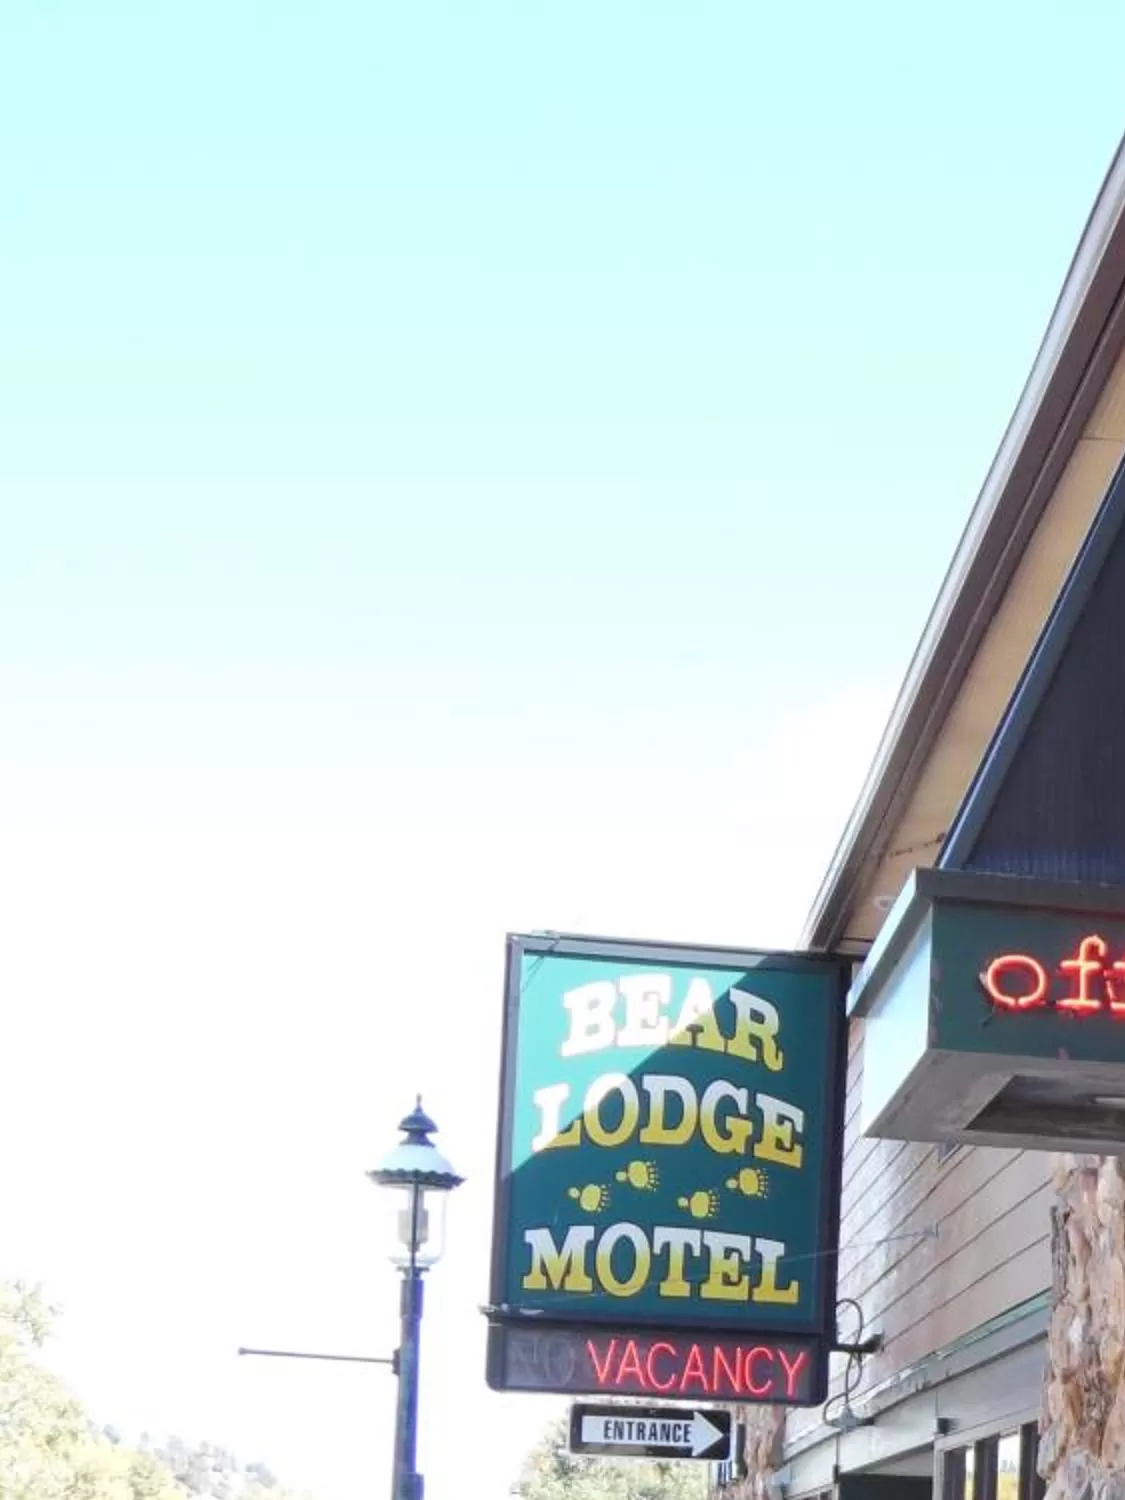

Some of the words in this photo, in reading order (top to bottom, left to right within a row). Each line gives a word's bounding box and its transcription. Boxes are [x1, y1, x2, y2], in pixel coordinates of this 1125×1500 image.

[561, 972, 784, 1073] BEAR
[532, 1073, 805, 1169] LODGE
[522, 1222, 799, 1304] MOTEL
[586, 1338, 807, 1396] VACANCY
[602, 1419, 693, 1446] ENTRANCE
